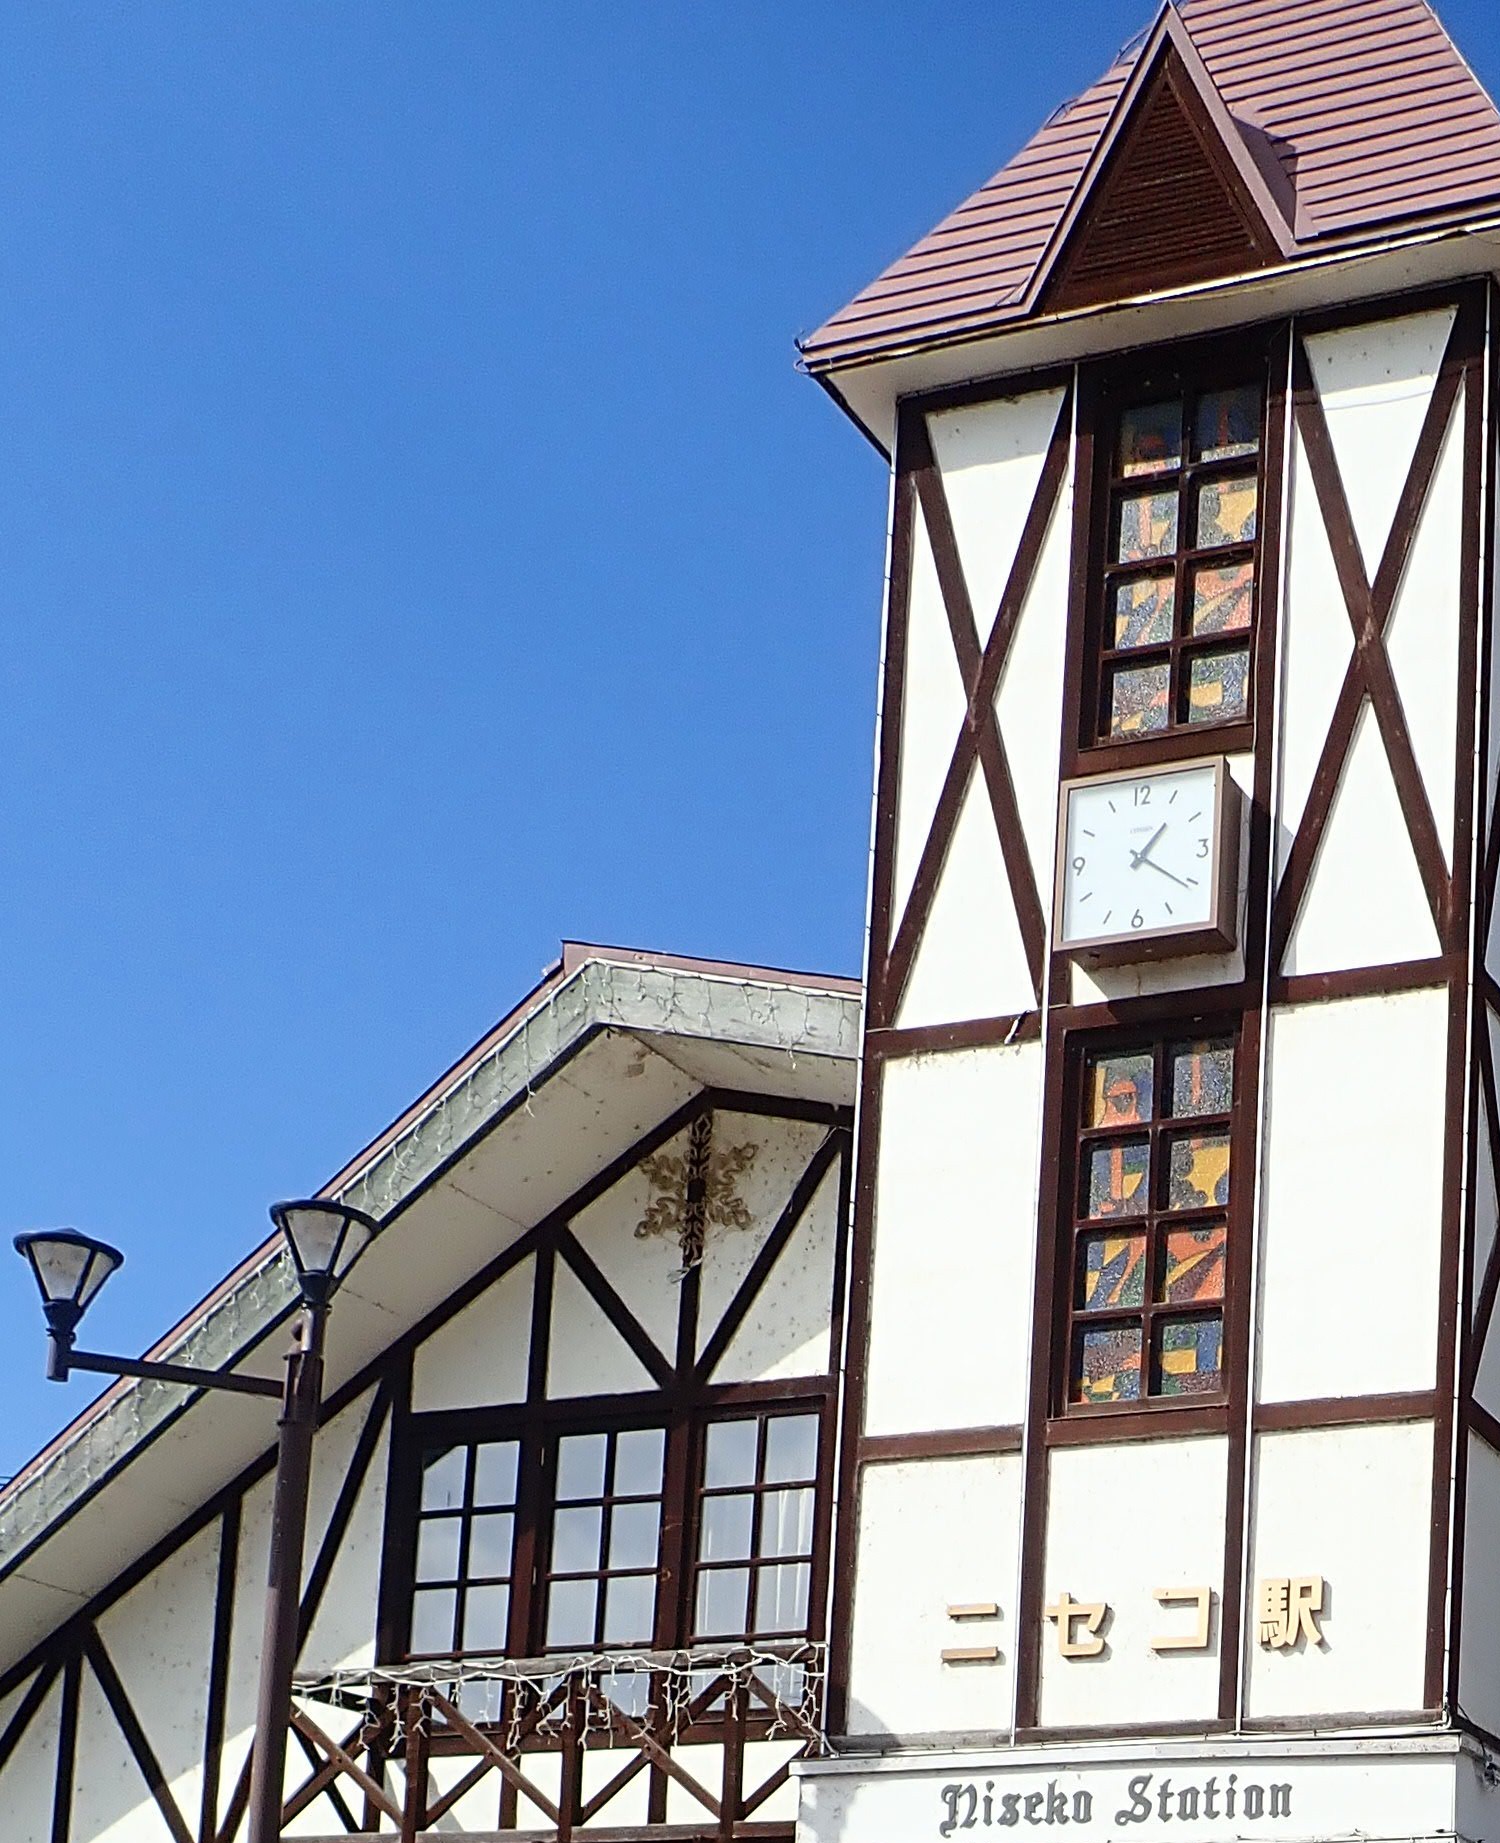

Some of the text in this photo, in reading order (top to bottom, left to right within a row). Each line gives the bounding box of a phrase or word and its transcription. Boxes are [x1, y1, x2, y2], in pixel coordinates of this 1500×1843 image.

[1134, 785, 1151, 807] 12
[1196, 838, 1209, 858] 3
[1072, 856, 1086, 876] 9
[1131, 909, 1144, 928] 6
[940, 1575, 1326, 1662] ニセコ駅
[938, 1772, 1293, 1839] Niseko Station
